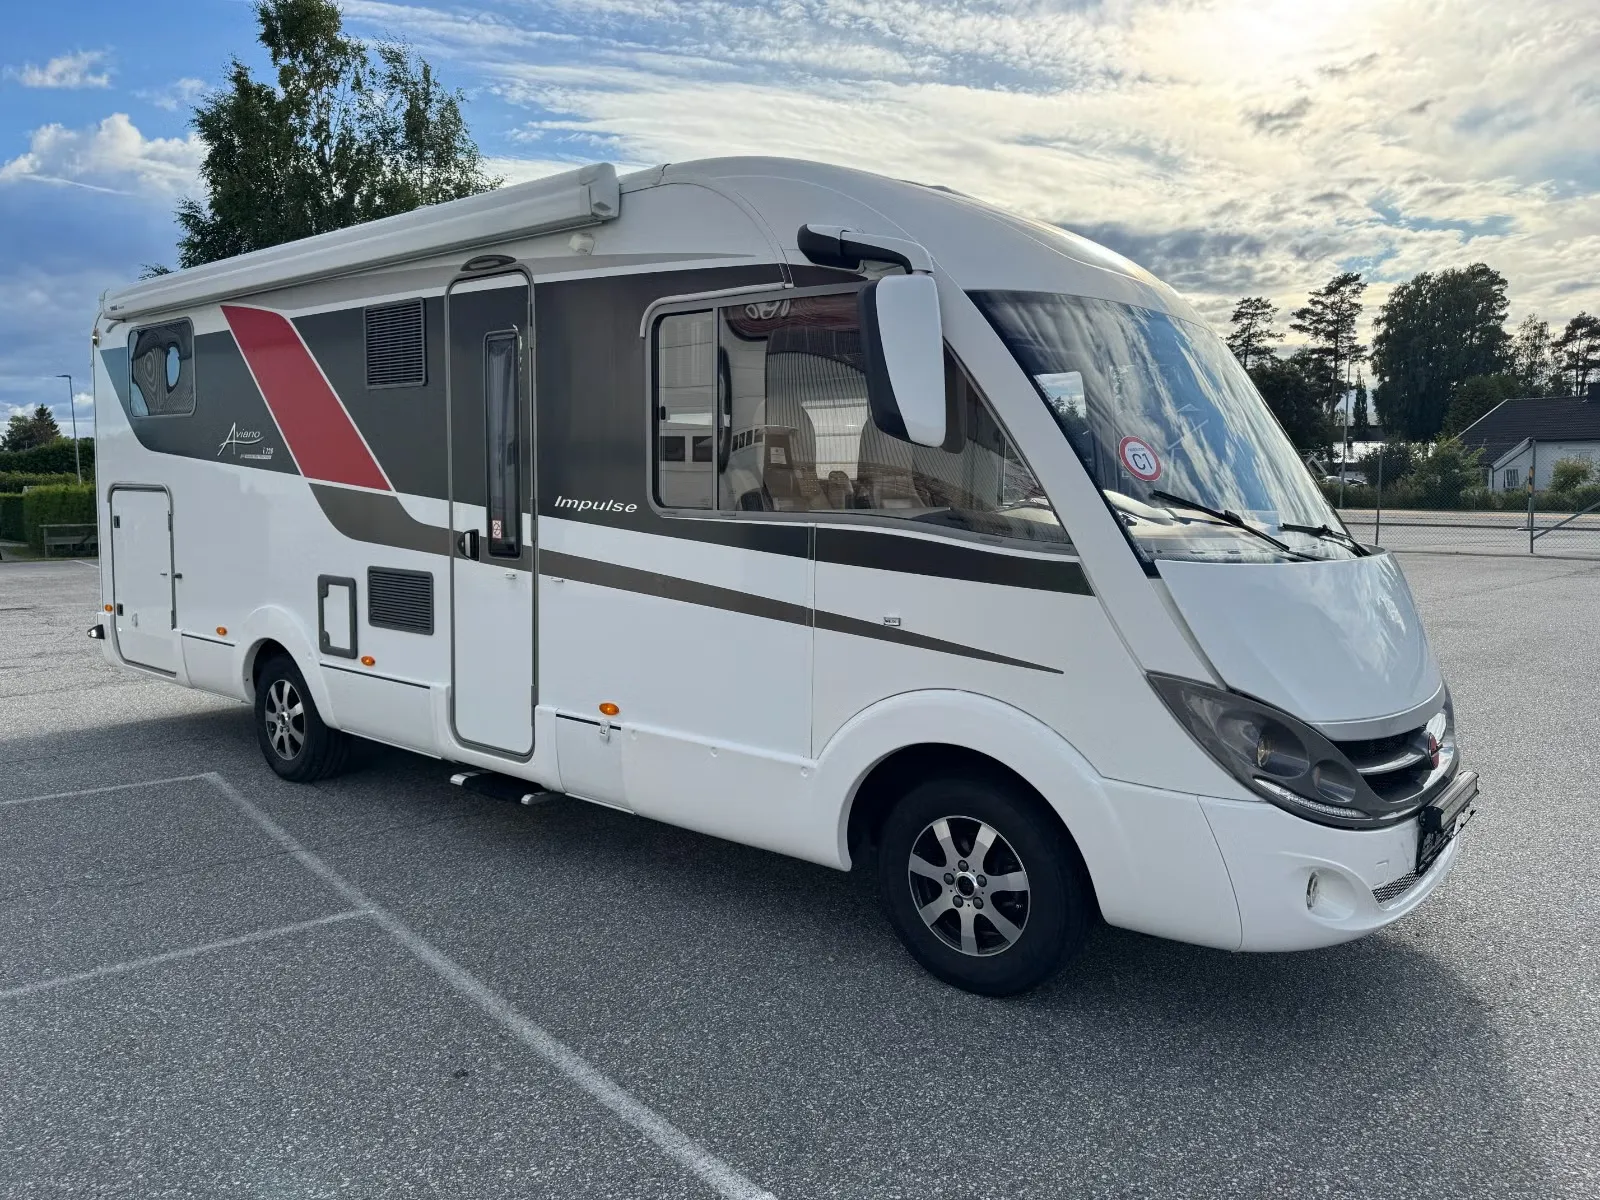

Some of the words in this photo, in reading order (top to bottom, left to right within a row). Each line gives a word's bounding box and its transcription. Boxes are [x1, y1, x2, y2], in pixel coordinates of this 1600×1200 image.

[217, 421, 264, 457] Aviano
[1132, 453, 1153, 470] C1
[554, 495, 638, 513] Impulse
